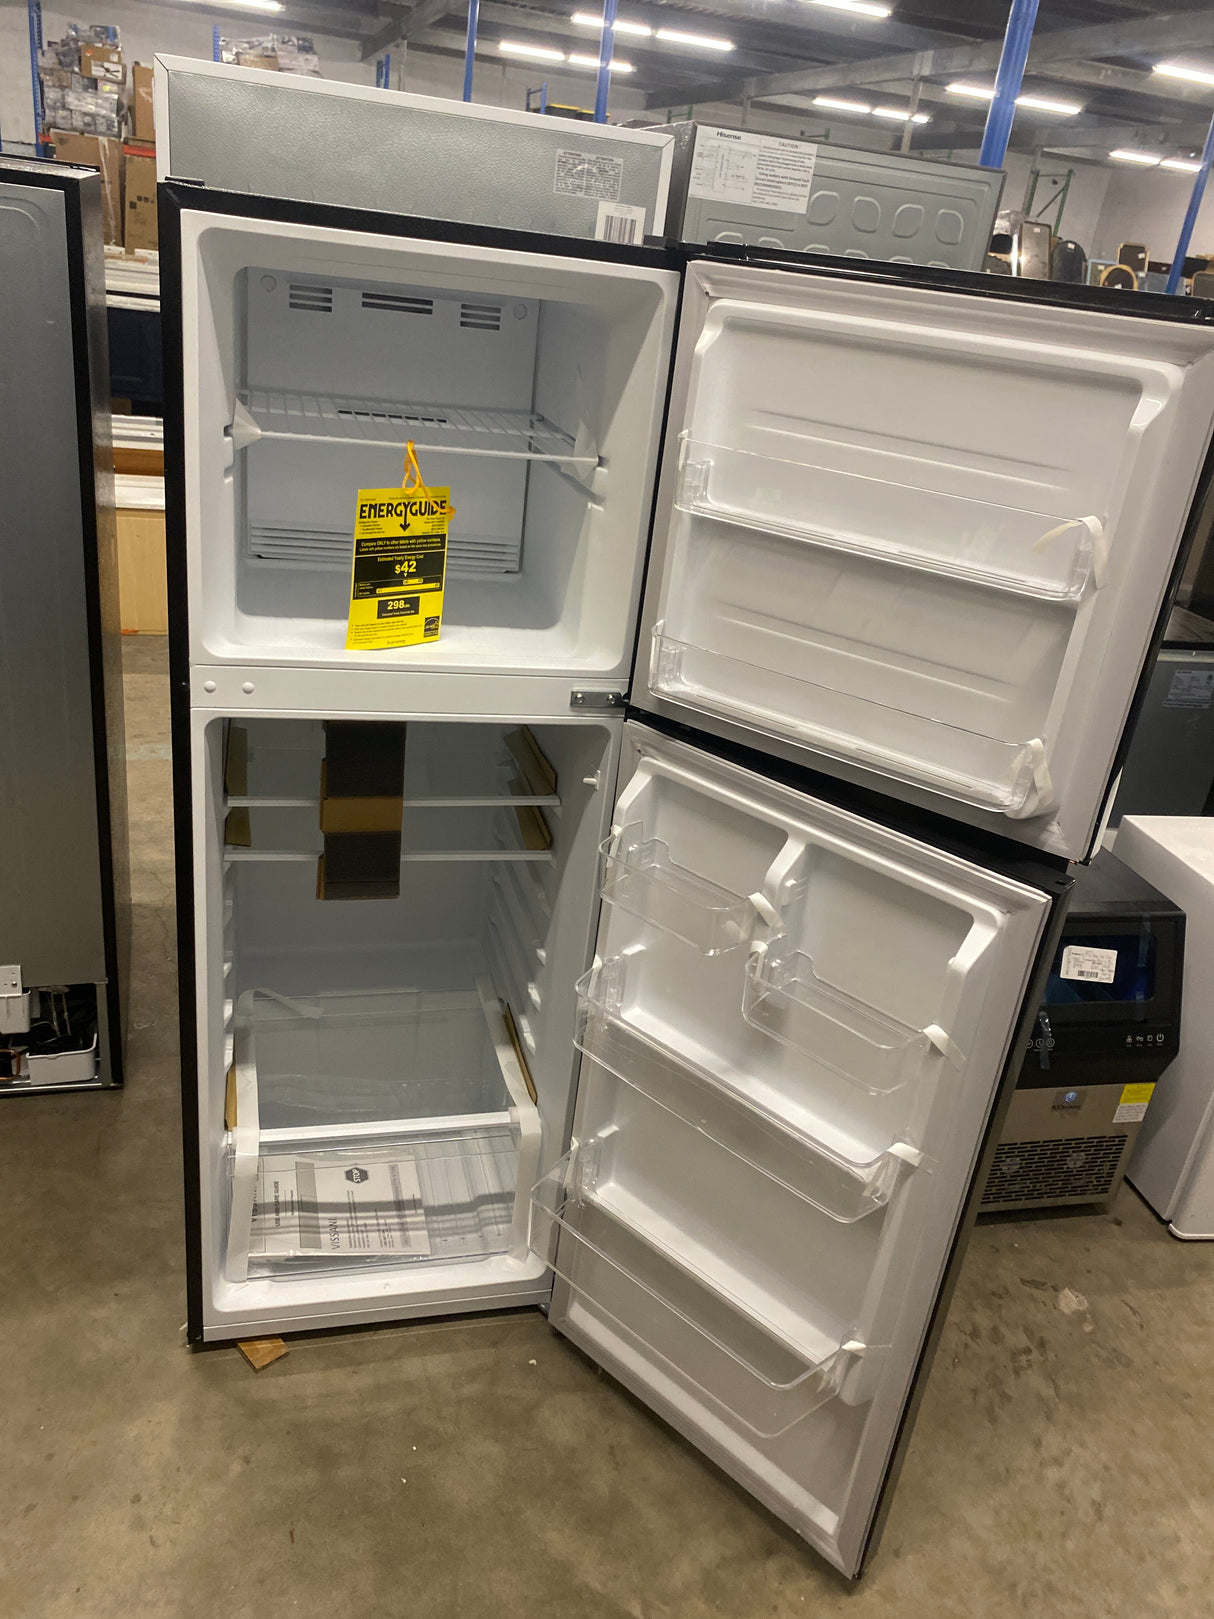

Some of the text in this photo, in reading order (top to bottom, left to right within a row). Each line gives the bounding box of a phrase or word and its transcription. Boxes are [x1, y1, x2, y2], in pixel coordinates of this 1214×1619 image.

[716, 130, 742, 140] Hisense
[359, 500, 447, 519] ENERGYGUIDE
[395, 560, 416, 574] $42
[387, 600, 404, 610] 298
[352, 1169, 361, 1182] STOP
